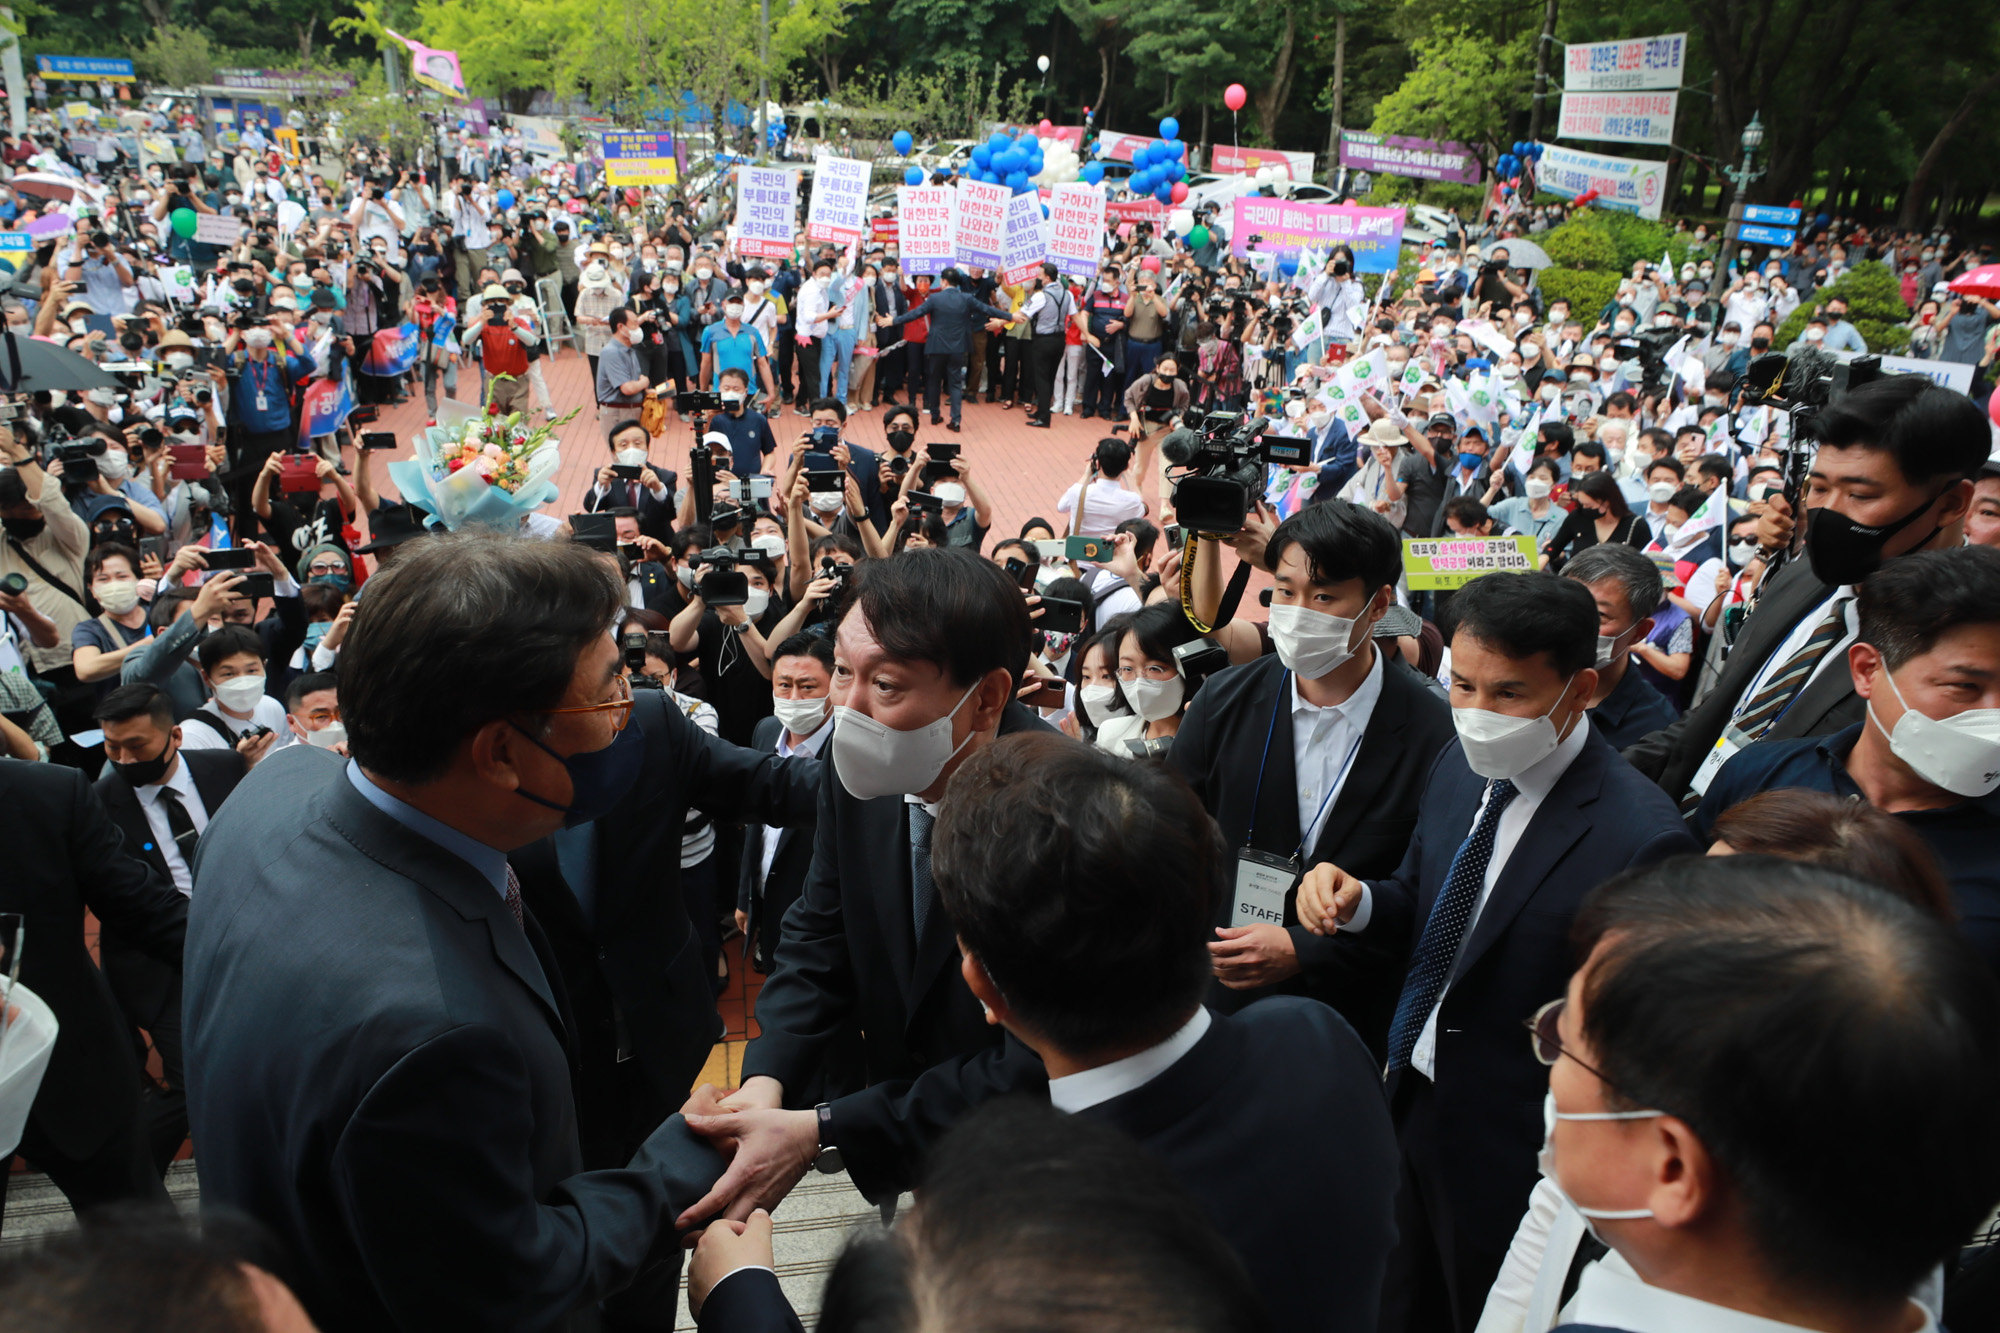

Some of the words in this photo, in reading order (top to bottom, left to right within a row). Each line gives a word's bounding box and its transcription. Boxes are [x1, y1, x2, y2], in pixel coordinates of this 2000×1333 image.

[828, 160, 861, 178] 국민의
[750, 171, 786, 188] 국민의
[819, 175, 864, 195] 부름대로
[743, 187, 791, 205] 부름대로
[823, 192, 857, 210] 국민의
[907, 190, 948, 205] 구하자!
[964, 183, 1004, 204] 구하자!
[1059, 191, 1099, 210] 구하자!
[750, 205, 785, 222] 국민의
[814, 207, 859, 227] 생각대로
[903, 207, 949, 222] 대한민국
[959, 199, 1004, 221] 대한민국
[1053, 206, 1099, 227] 대한민국
[742, 221, 790, 239] 생각대로
[960, 216, 1000, 236] 나와라!
[1243, 205, 1281, 226] 국민이
[1282, 208, 1315, 232] 원하는
[1357, 216, 1395, 236] 윤석열
[0, 234, 27, 247] 석열
[907, 224, 948, 239] 나와라!
[1006, 228, 1040, 250] 국민의
[1055, 223, 1095, 242] 나와라!
[1005, 242, 1047, 268] 생각대로
[1240, 902, 1282, 923] STAFF
